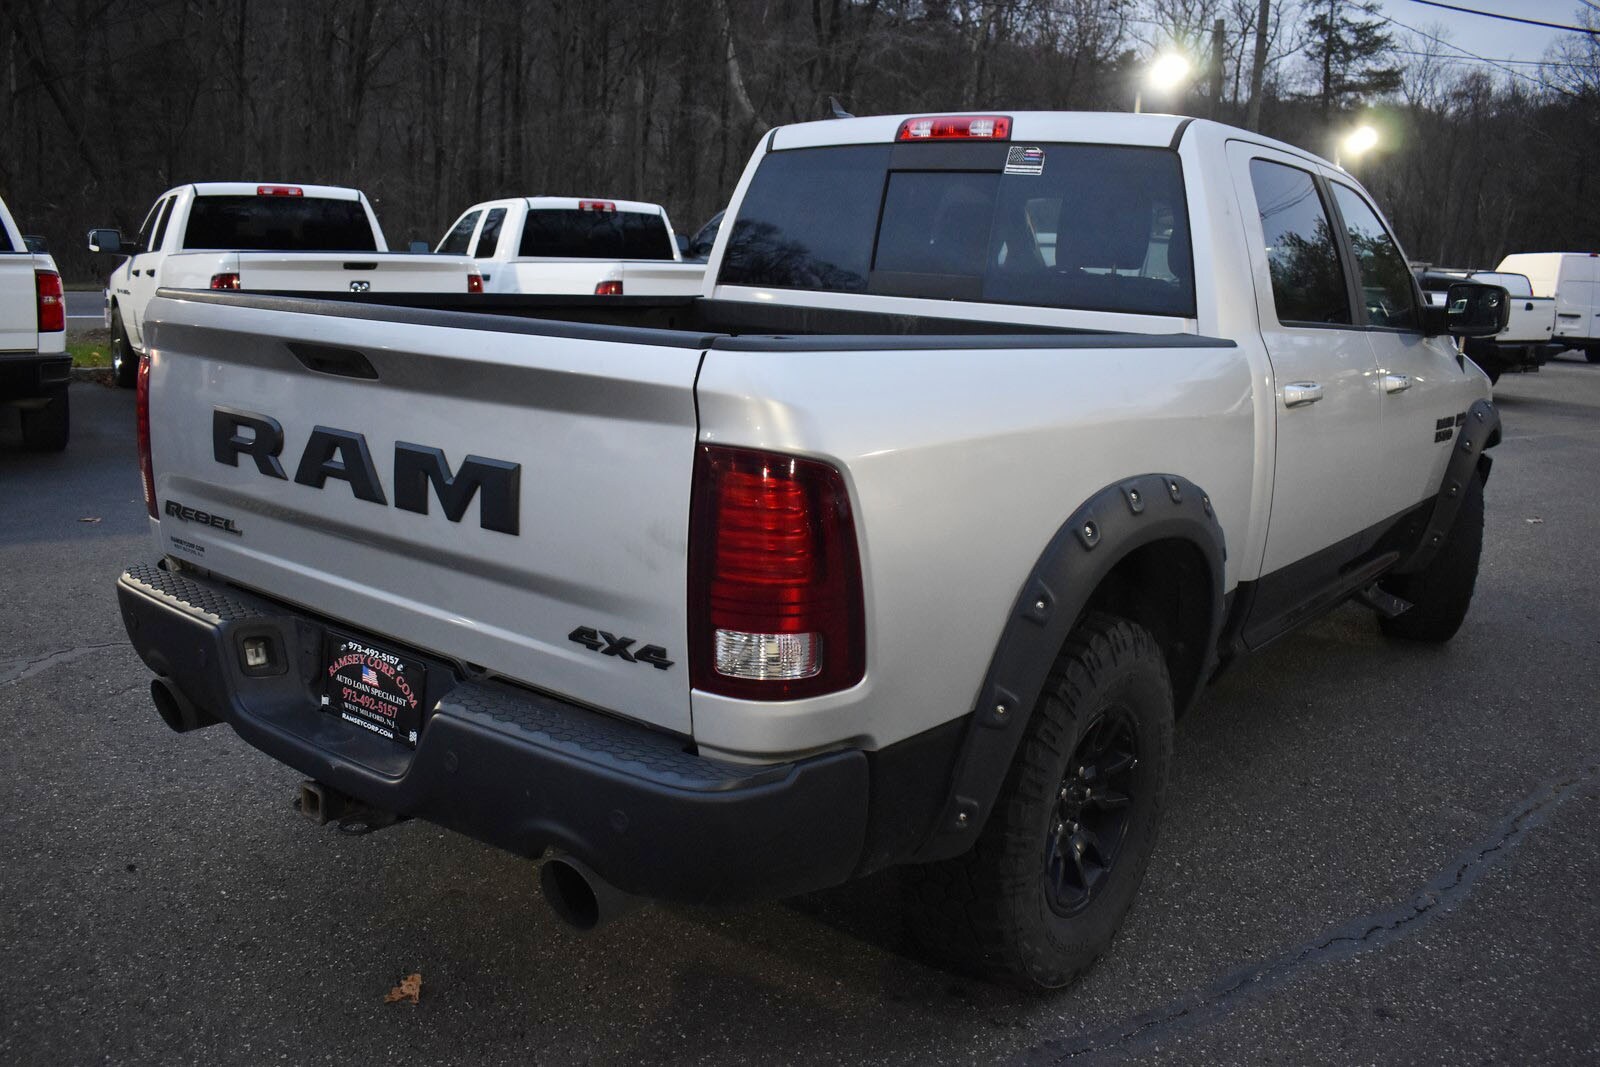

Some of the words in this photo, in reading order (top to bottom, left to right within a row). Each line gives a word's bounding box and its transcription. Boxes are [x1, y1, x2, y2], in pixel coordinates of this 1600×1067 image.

[212, 404, 522, 537] RAM
[165, 499, 243, 537] REBEL
[328, 653, 367, 677] RAMSEY
[348, 641, 400, 665] 973-492-5157
[336, 674, 353, 686] AUTO
[353, 680, 370, 693] LOAN
[370, 686, 407, 707] SPECIALIST
[342, 687, 398, 719] 973-492-5157
[344, 701, 359, 713] WEST
[341, 712, 394, 739] RAMSEYCORP.COM
